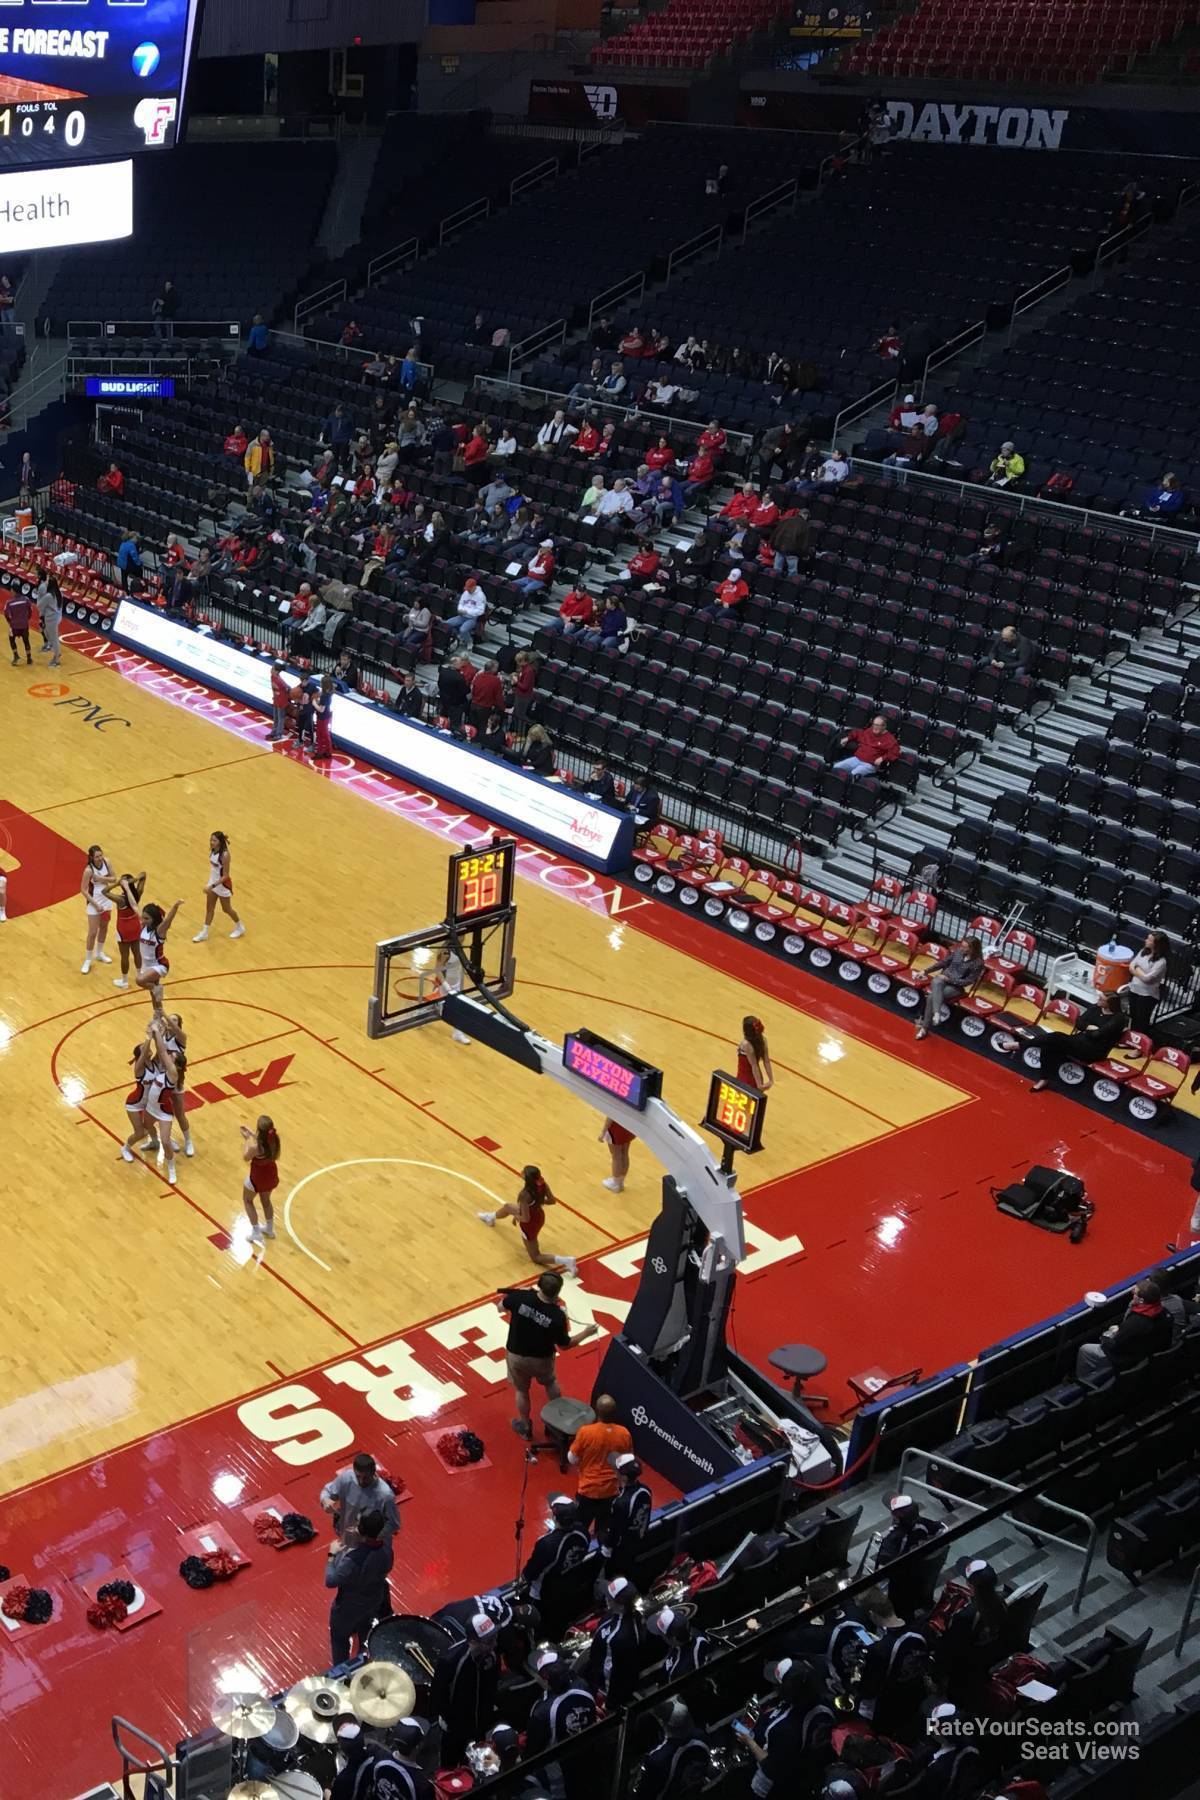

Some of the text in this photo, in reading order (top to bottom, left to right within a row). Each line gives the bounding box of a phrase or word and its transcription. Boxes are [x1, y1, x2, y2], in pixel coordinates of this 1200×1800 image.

[13, 29, 110, 59] FORECAST
[16, 103, 40, 114] FOULS
[43, 102, 58, 111] TOL
[21, 118, 33, 137] 0
[43, 115, 56, 135] 4
[64, 110, 86, 147] 0
[886, 100, 1069, 150] DAYTON
[101, 382, 125, 392] BUD
[54, 695, 132, 733] PNC
[459, 851, 505, 880] 33:21
[464, 873, 497, 912] 30
[571, 1040, 634, 1084] DAYTON
[572, 1056, 631, 1099] FLYERS
[1096, 1081, 1117, 1097] Kroger
[719, 1082, 756, 1115] 33:21
[1133, 1099, 1154, 1115] Kroger
[723, 1104, 747, 1133] 30
[648, 1419, 715, 1475] Premier Health
